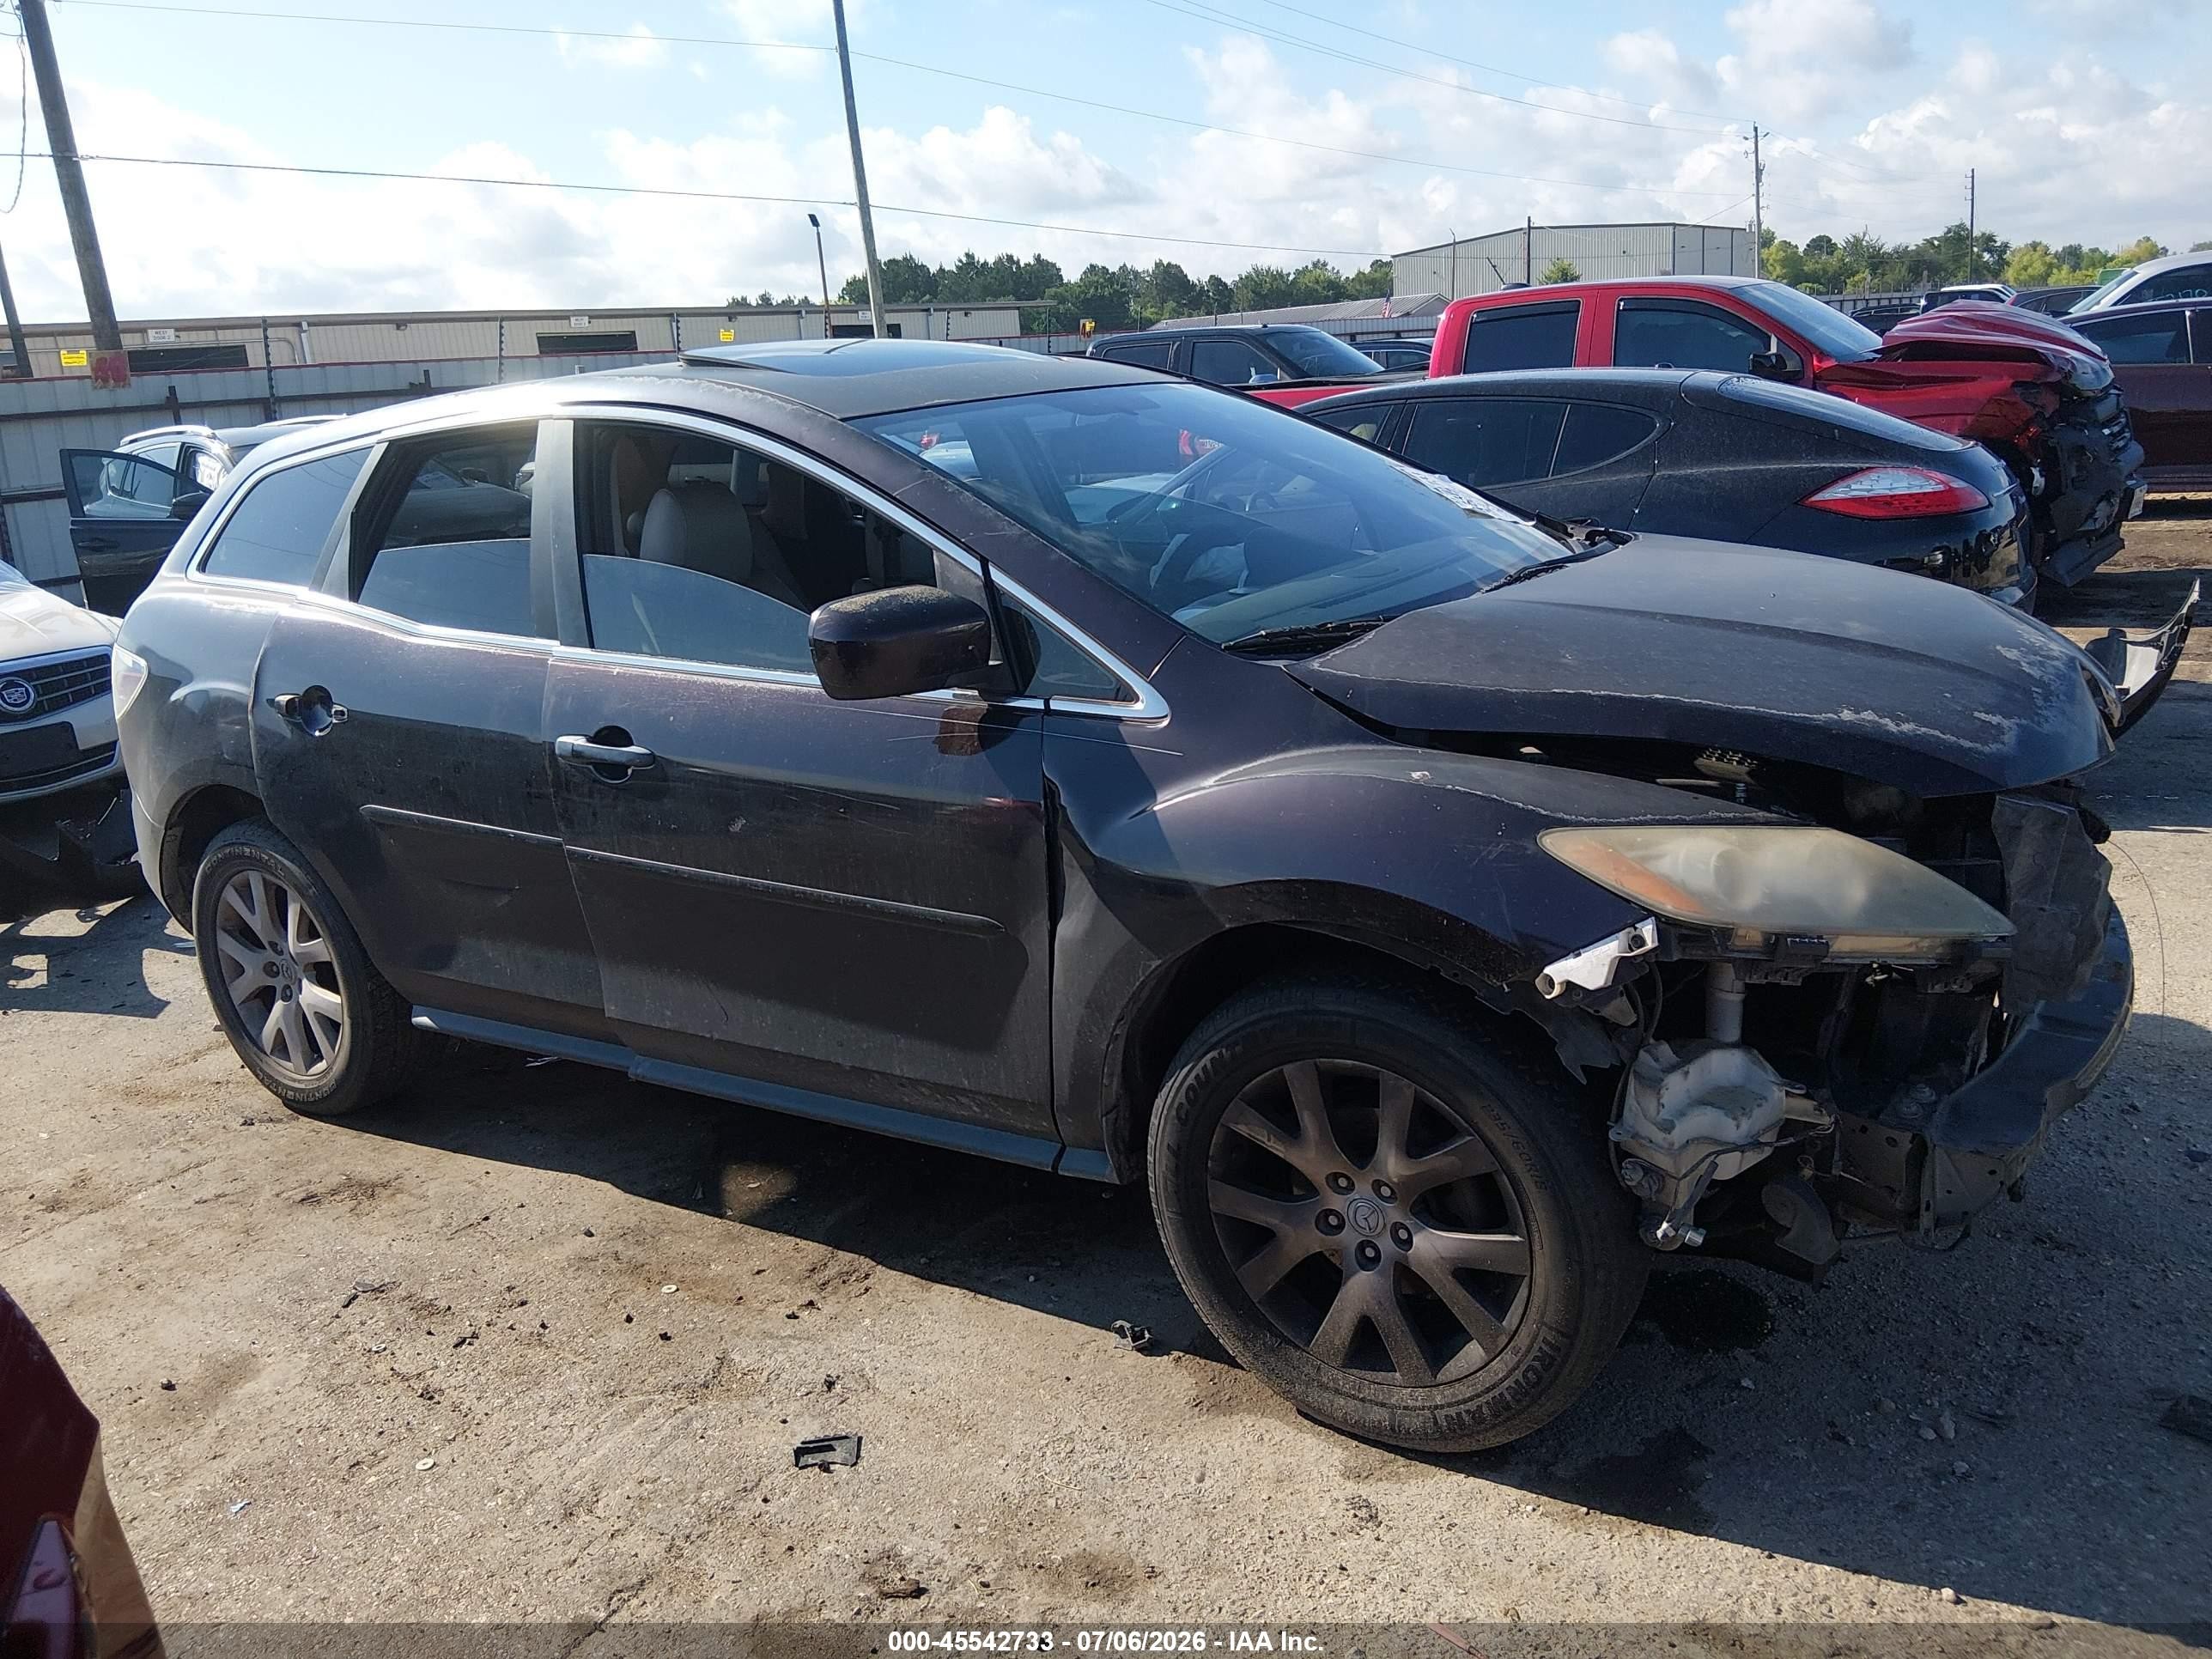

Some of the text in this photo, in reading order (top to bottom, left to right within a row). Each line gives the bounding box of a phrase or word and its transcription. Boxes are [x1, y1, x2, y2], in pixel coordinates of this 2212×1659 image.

[204, 846, 285, 877] CONTINENTAL
[256, 1066, 337, 1103] CONTINENTAL
[1443, 1336, 1562, 1433] IRONMAN
